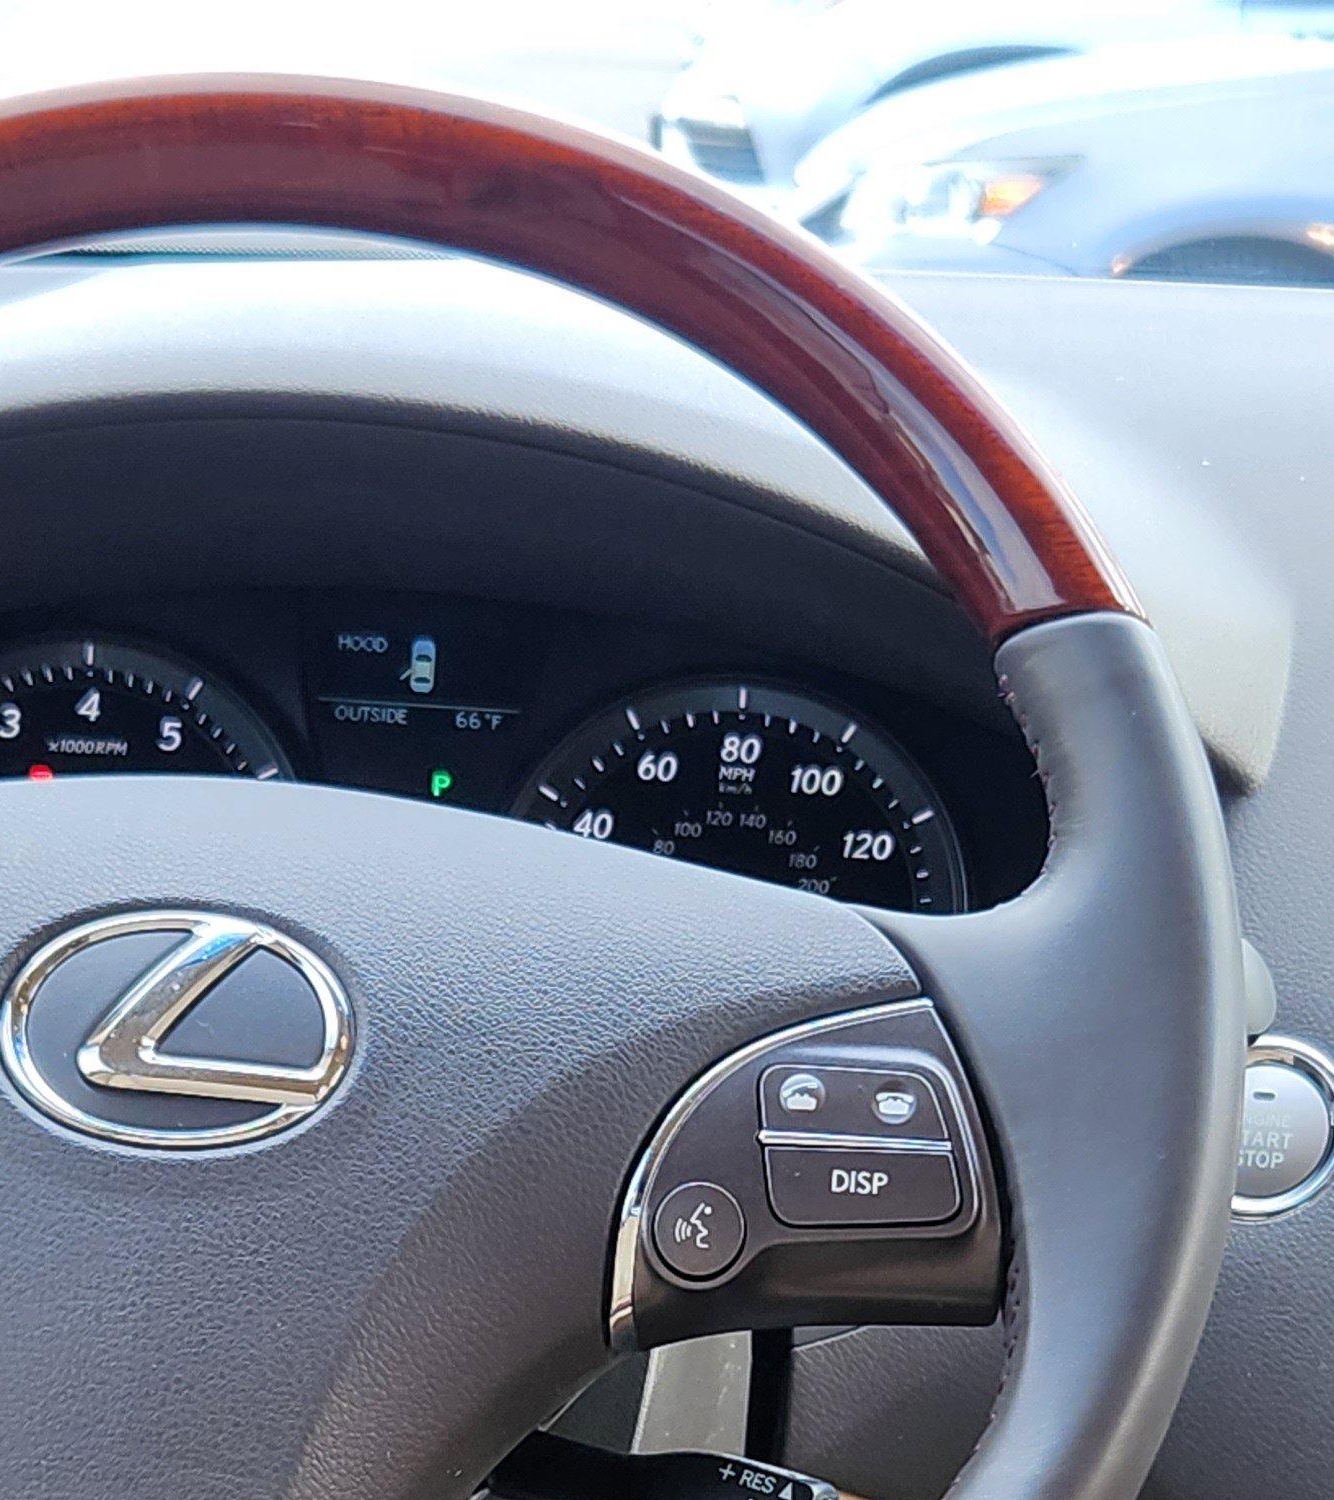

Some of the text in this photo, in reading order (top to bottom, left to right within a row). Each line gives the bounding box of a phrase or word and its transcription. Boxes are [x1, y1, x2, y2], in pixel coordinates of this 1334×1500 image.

[337, 635, 389, 653] HOOD
[76, 687, 102, 723] 4
[334, 705, 409, 725] OUTSIDE
[158, 716, 183, 751] 5
[720, 732, 761, 763] 80
[637, 752, 678, 782] 60
[718, 766, 755, 782] MPH
[431, 770, 453, 797] P
[790, 767, 844, 796] 100
[573, 809, 614, 839] 40
[674, 821, 703, 837] 100
[706, 811, 733, 827] 120
[738, 812, 767, 829] 140
[653, 839, 675, 855] 80
[768, 828, 797, 846] 160
[842, 831, 895, 861] 120
[789, 852, 818, 869] 180
[1241, 1130, 1294, 1150] TART
[830, 1168, 890, 1195] DISP
[739, 1469, 778, 1495] RES
